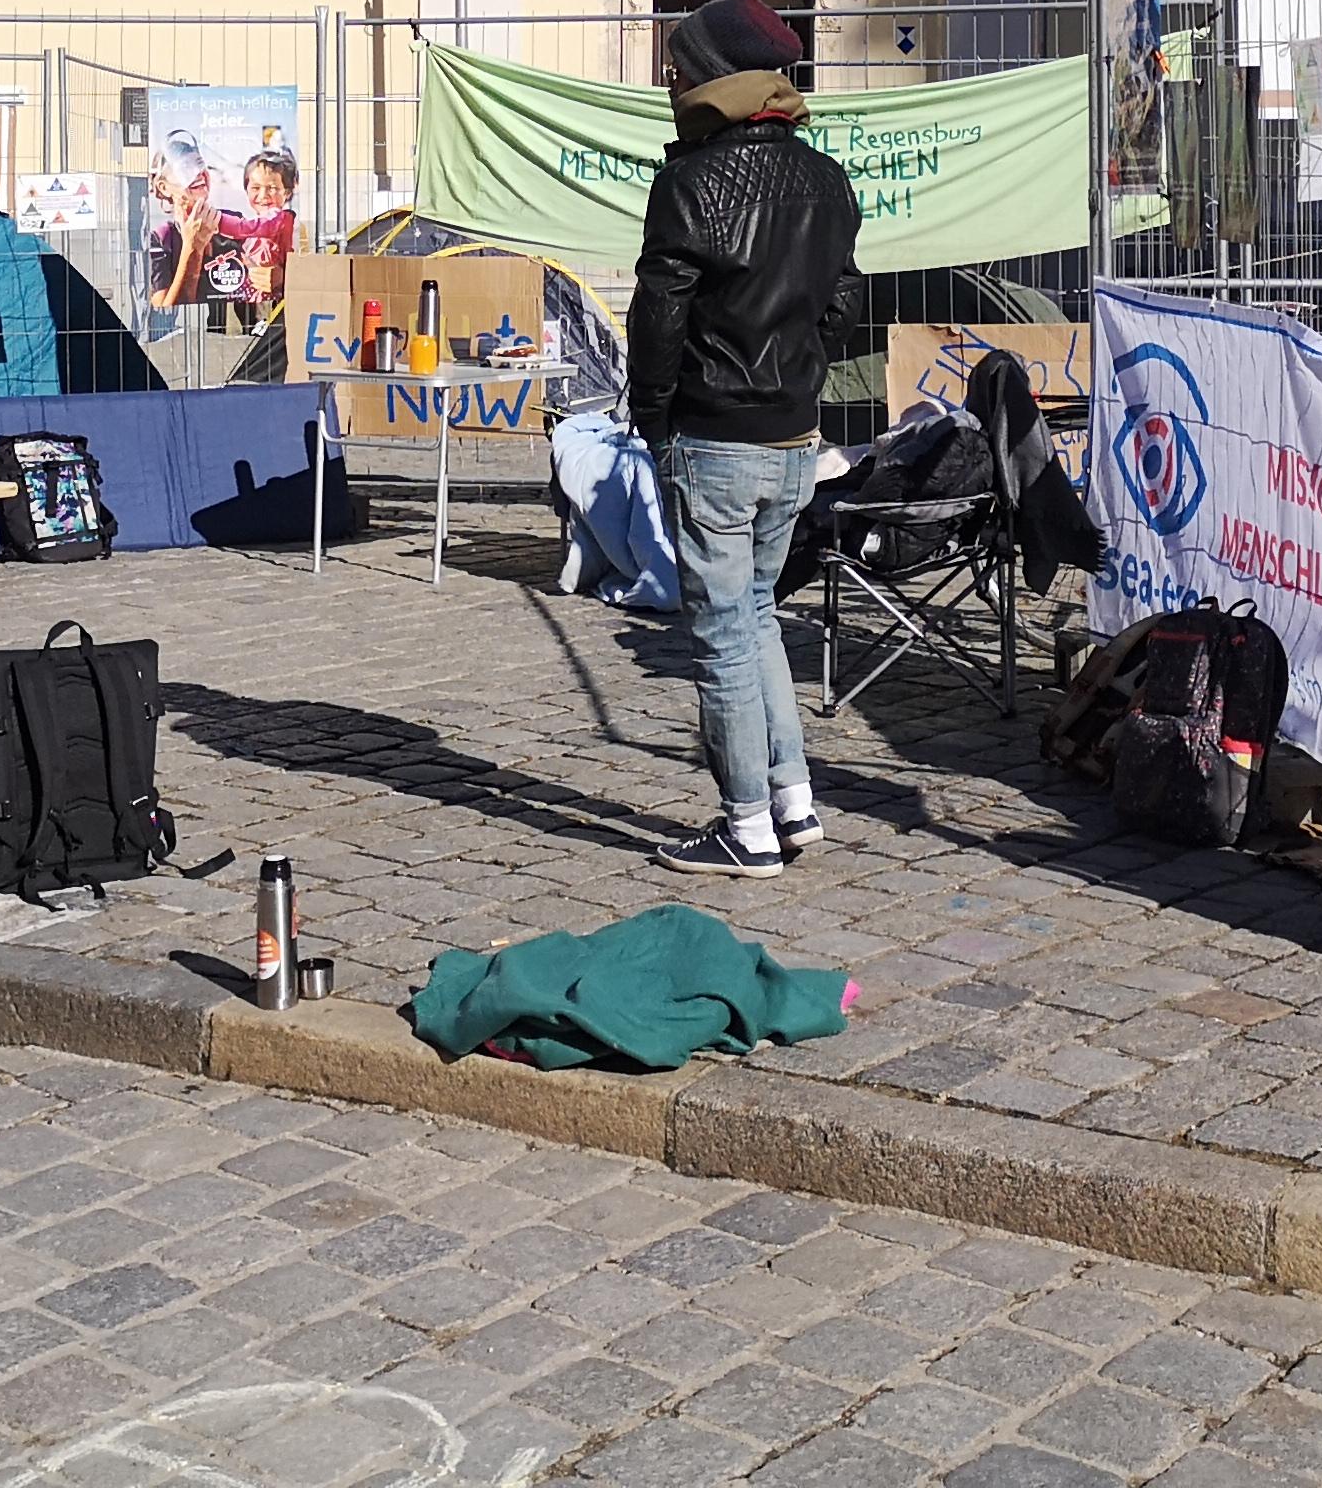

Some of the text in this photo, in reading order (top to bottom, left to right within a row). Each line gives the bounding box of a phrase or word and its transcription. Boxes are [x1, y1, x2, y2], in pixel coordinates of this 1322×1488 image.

[154, 94, 293, 112] Jeder kann helfen.
[792, 122, 982, 154] SYL Regensburg
[560, 148, 665, 183] MENSC
[386, 378, 533, 428] NOW
